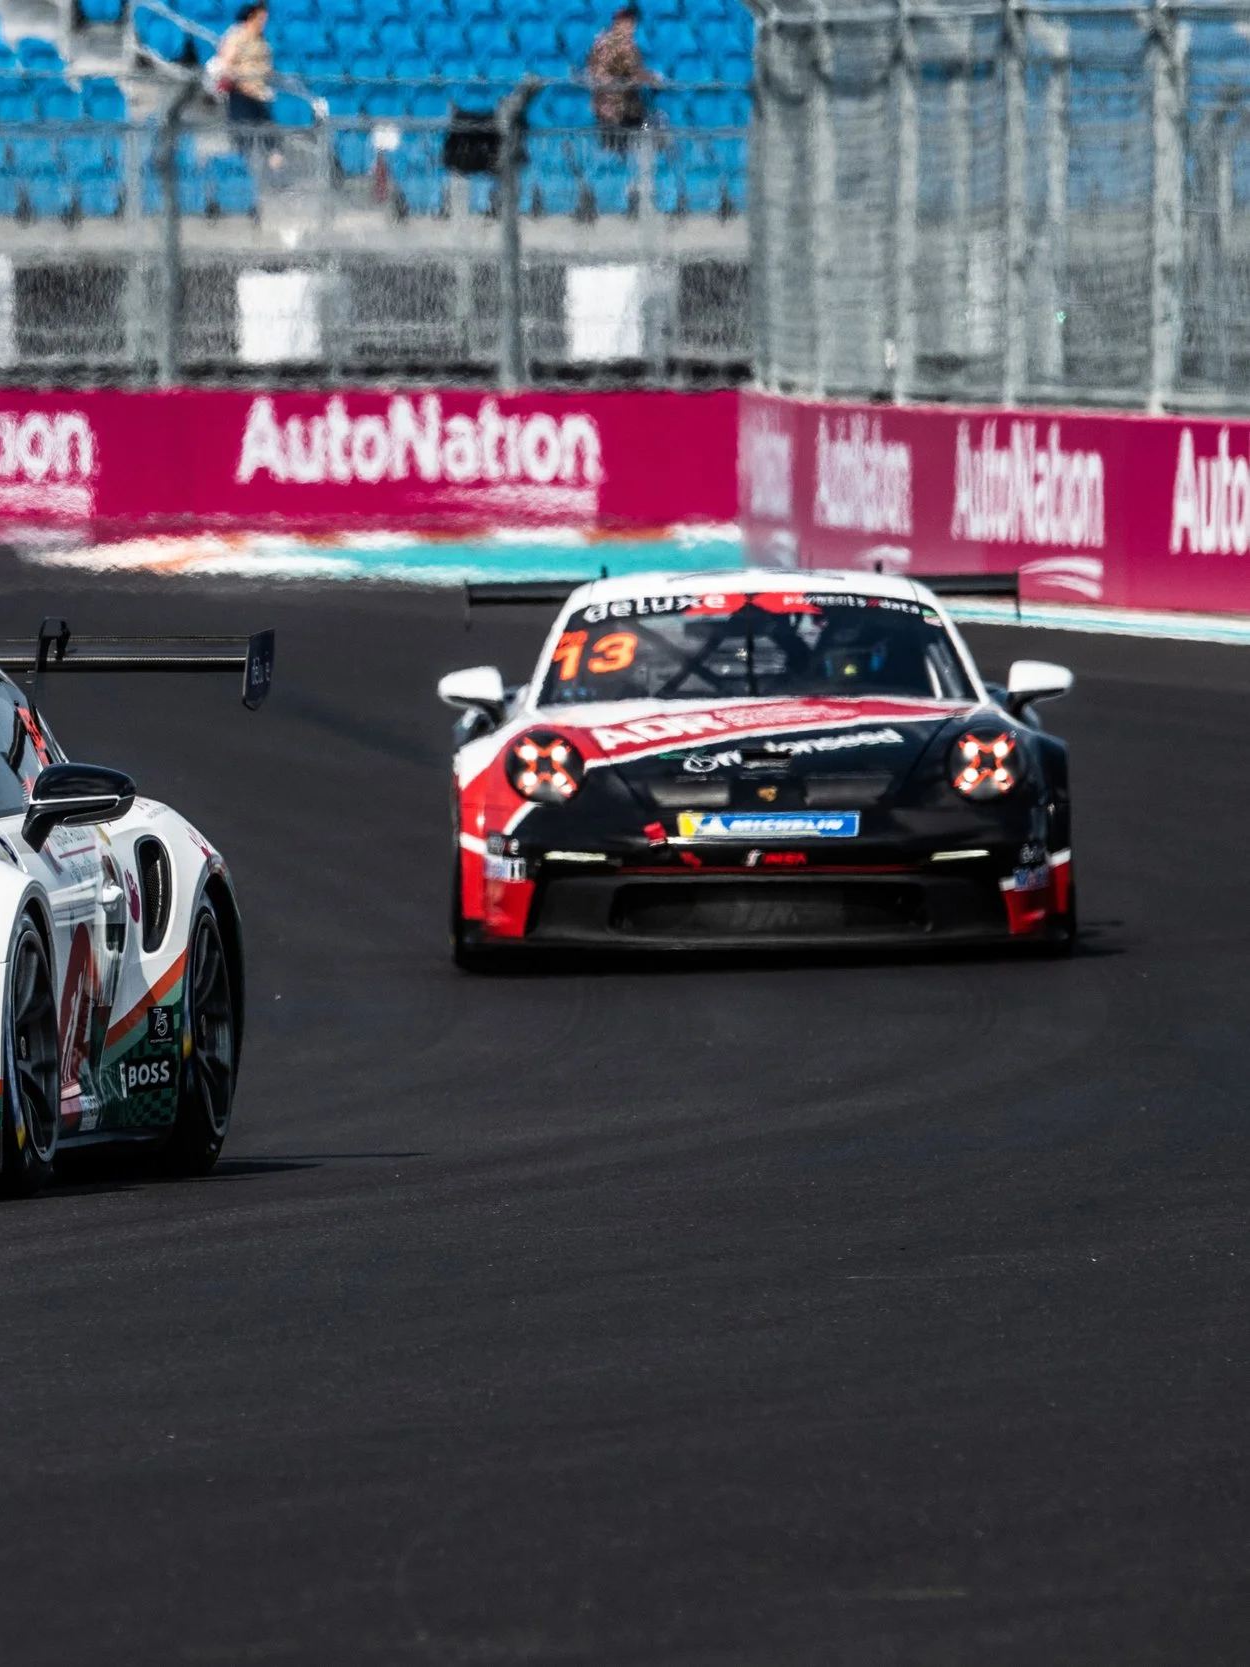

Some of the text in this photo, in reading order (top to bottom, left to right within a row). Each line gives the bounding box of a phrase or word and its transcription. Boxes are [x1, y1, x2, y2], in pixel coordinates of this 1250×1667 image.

[235, 393, 603, 485] AutoNation
[952, 418, 1105, 548] AutoNation
[583, 594, 726, 623] deluxe
[553, 632, 638, 682] 13
[591, 713, 728, 750] ADR
[729, 818, 846, 832] MICHELIN
[128, 1060, 171, 1089] BOSS
